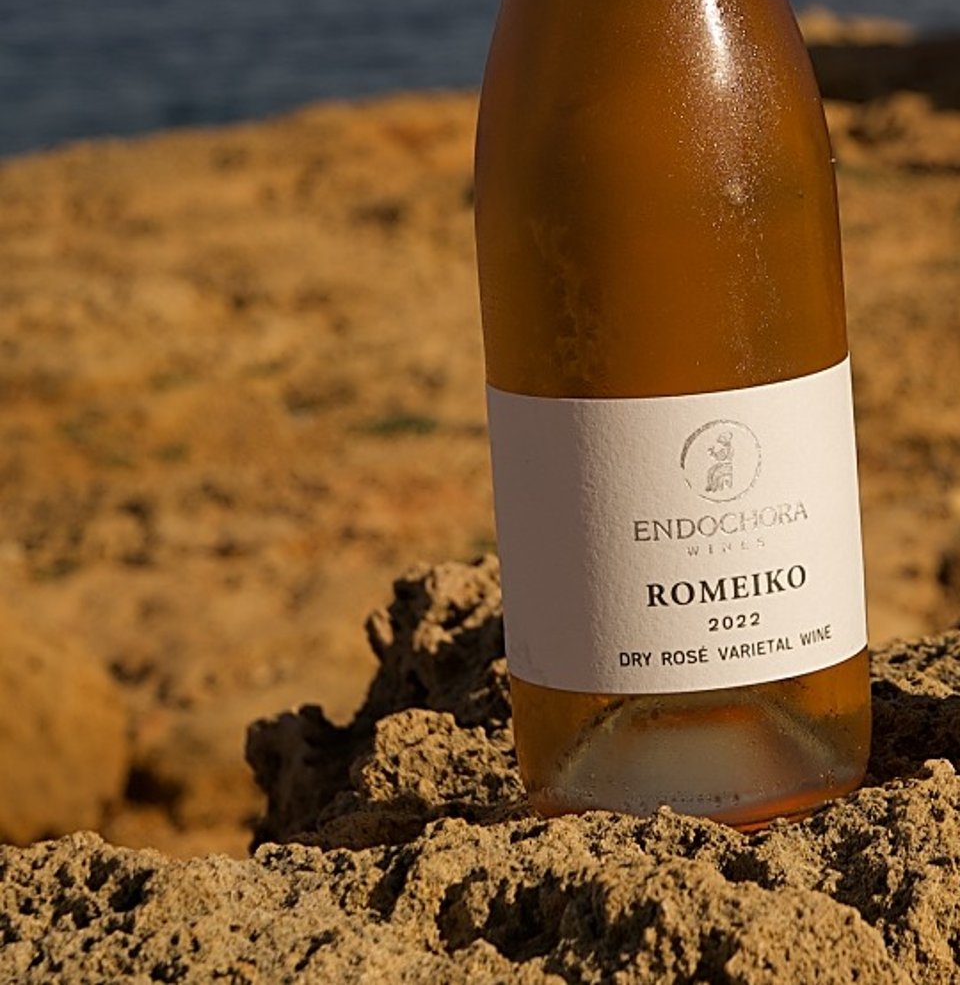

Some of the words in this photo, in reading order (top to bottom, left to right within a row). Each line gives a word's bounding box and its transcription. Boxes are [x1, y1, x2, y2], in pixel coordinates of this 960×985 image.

[633, 502, 808, 541] ENDOCHORA
[687, 537, 766, 556] WINES
[646, 564, 806, 606] ROMEIKO
[708, 612, 760, 631] 2022
[619, 651, 651, 667] DRY
[661, 645, 707, 666] ROSÉ
[717, 638, 792, 661] VARIETAL
[800, 624, 831, 646] WINE
